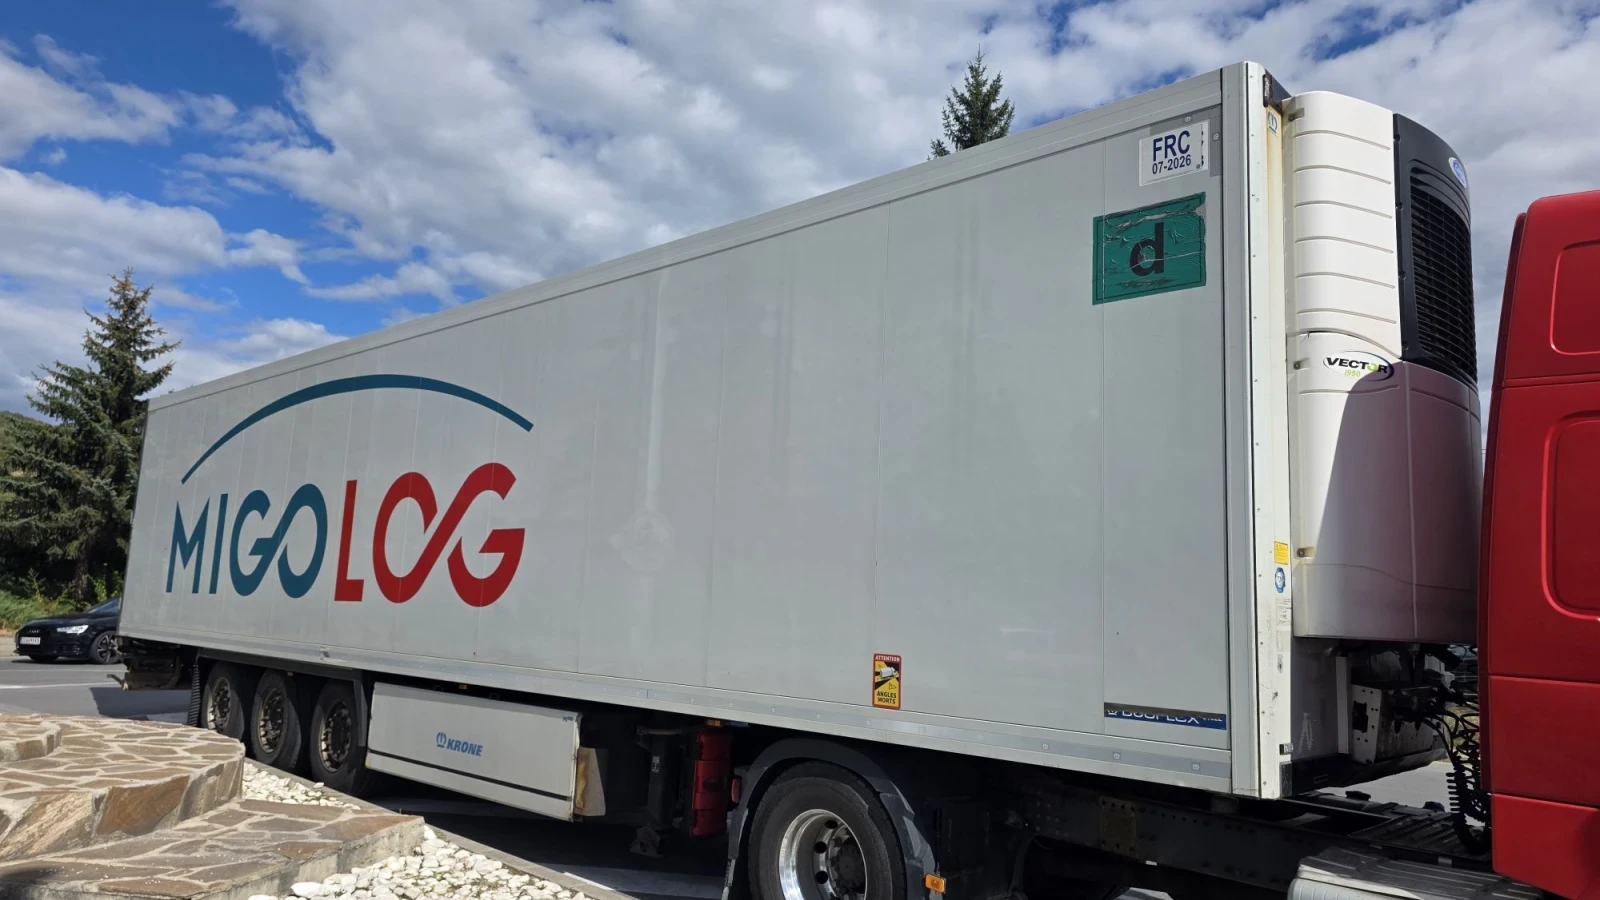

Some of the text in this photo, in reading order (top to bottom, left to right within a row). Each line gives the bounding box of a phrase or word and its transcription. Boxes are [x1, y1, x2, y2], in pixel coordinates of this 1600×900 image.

[1153, 130, 1191, 162] FRC
[1152, 154, 1192, 175] 07-2026
[1129, 221, 1165, 276] d
[1326, 357, 1388, 374] VECTOR
[877, 691, 897, 699] ANGLES
[877, 697, 896, 705] MORTS
[446, 738, 484, 757] KRONE
